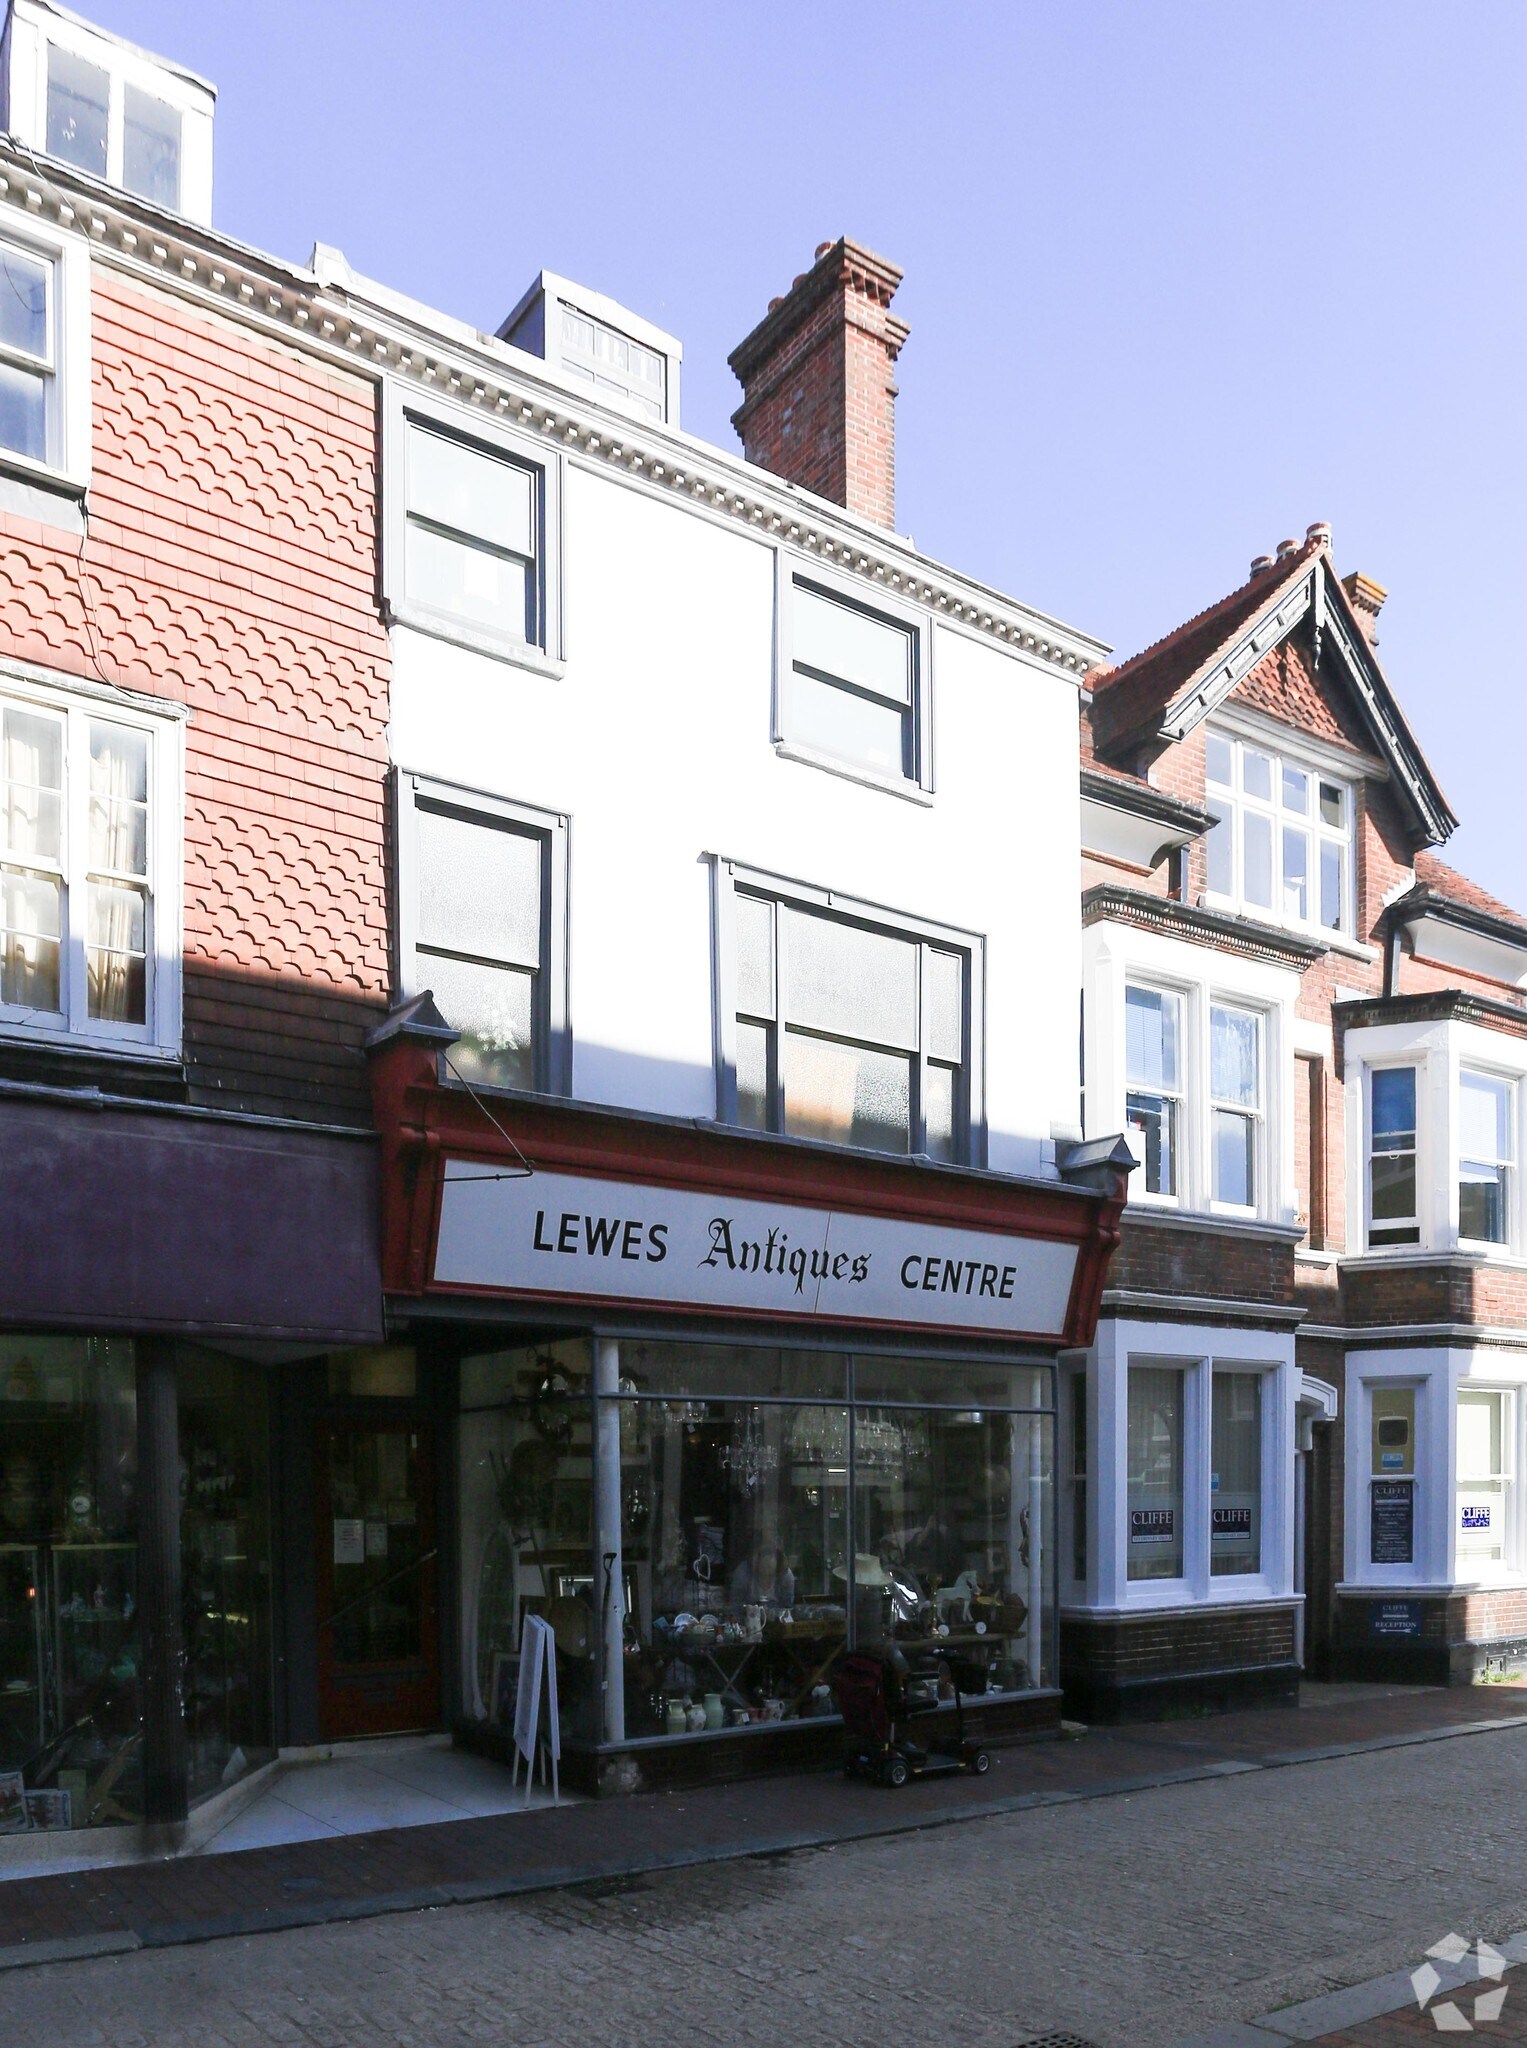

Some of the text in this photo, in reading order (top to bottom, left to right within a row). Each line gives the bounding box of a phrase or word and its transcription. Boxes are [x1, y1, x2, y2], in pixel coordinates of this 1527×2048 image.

[534, 1211, 1016, 1298] LEWES Antiques CENTRE
[1132, 1511, 1173, 1525] CLIFFE
[1213, 1510, 1250, 1523] CLIFFE
[1462, 1508, 1490, 1518] CLIFFE
